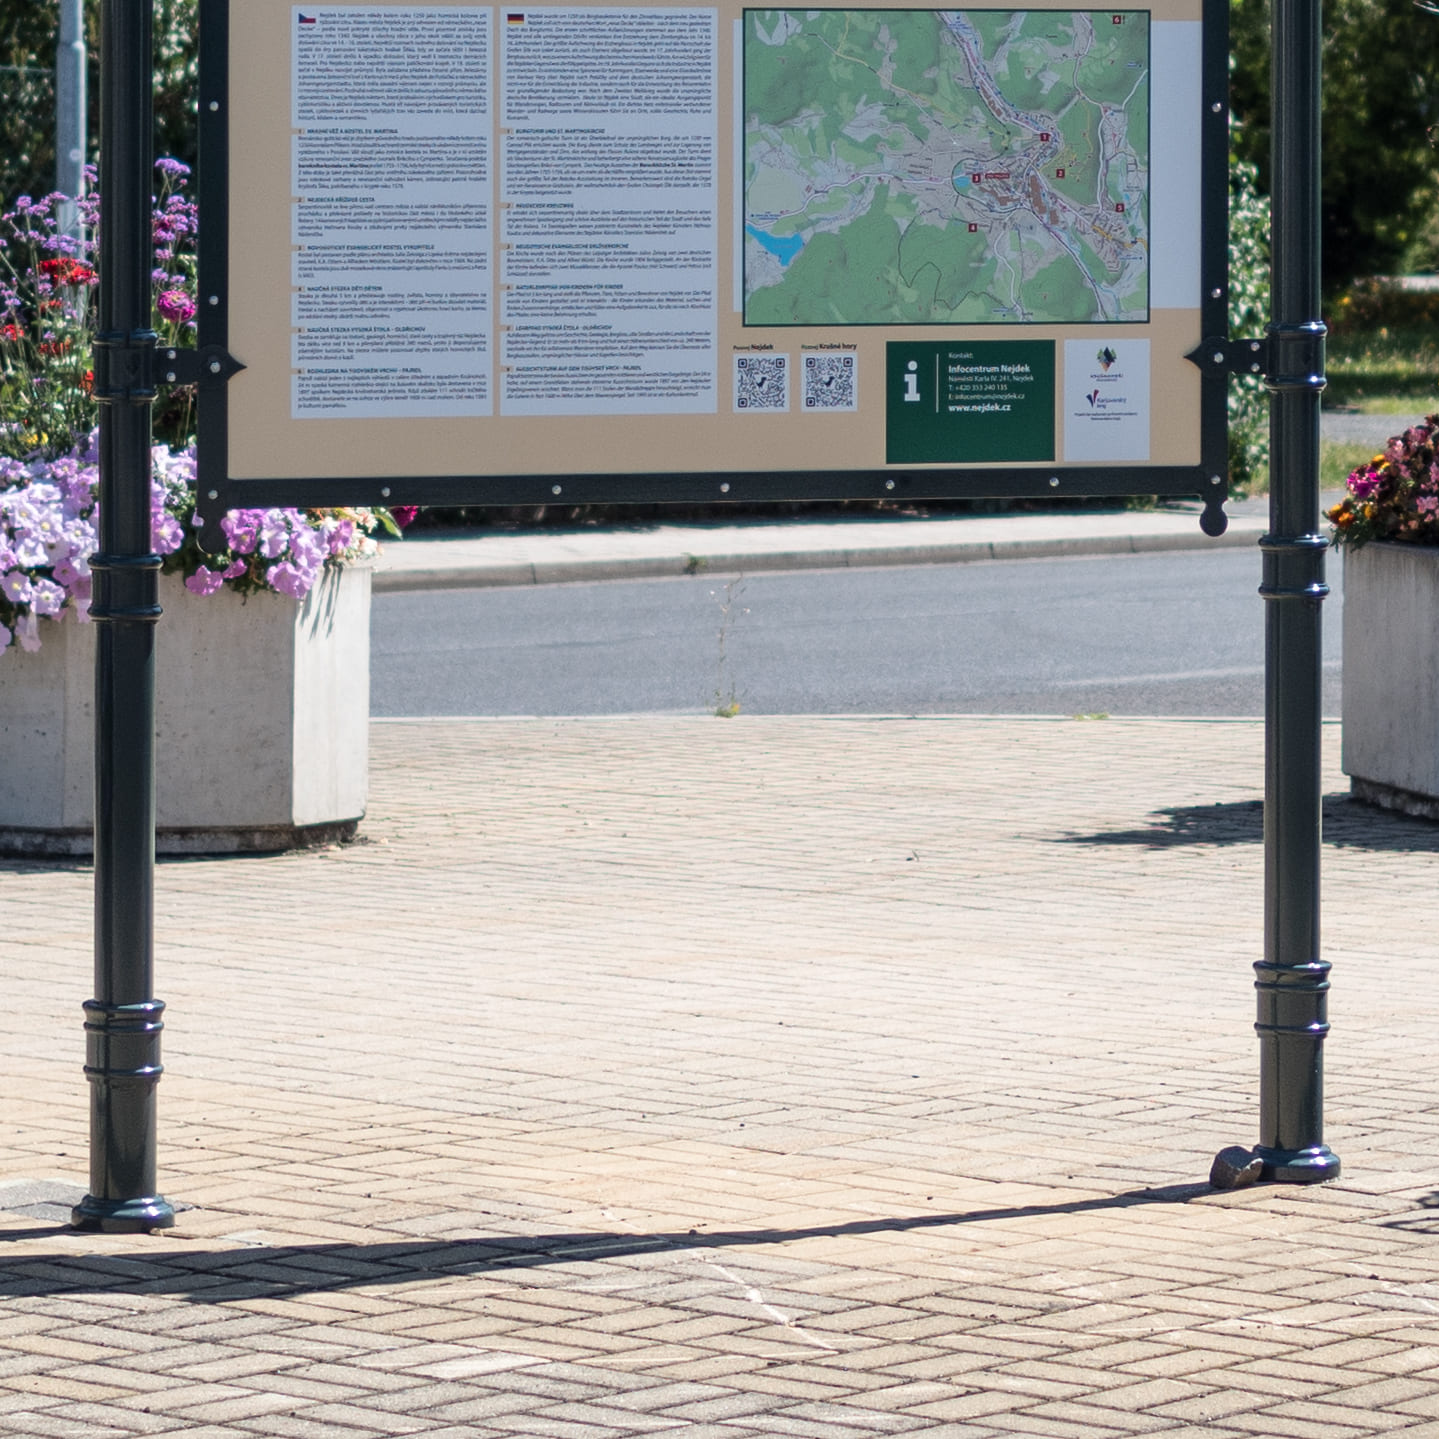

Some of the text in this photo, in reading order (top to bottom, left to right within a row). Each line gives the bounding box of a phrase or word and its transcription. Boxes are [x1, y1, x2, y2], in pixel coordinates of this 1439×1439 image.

[948, 364, 1030, 374] Infocentrum Nejdek
[948, 403, 1011, 413] www.nejdek.cz
